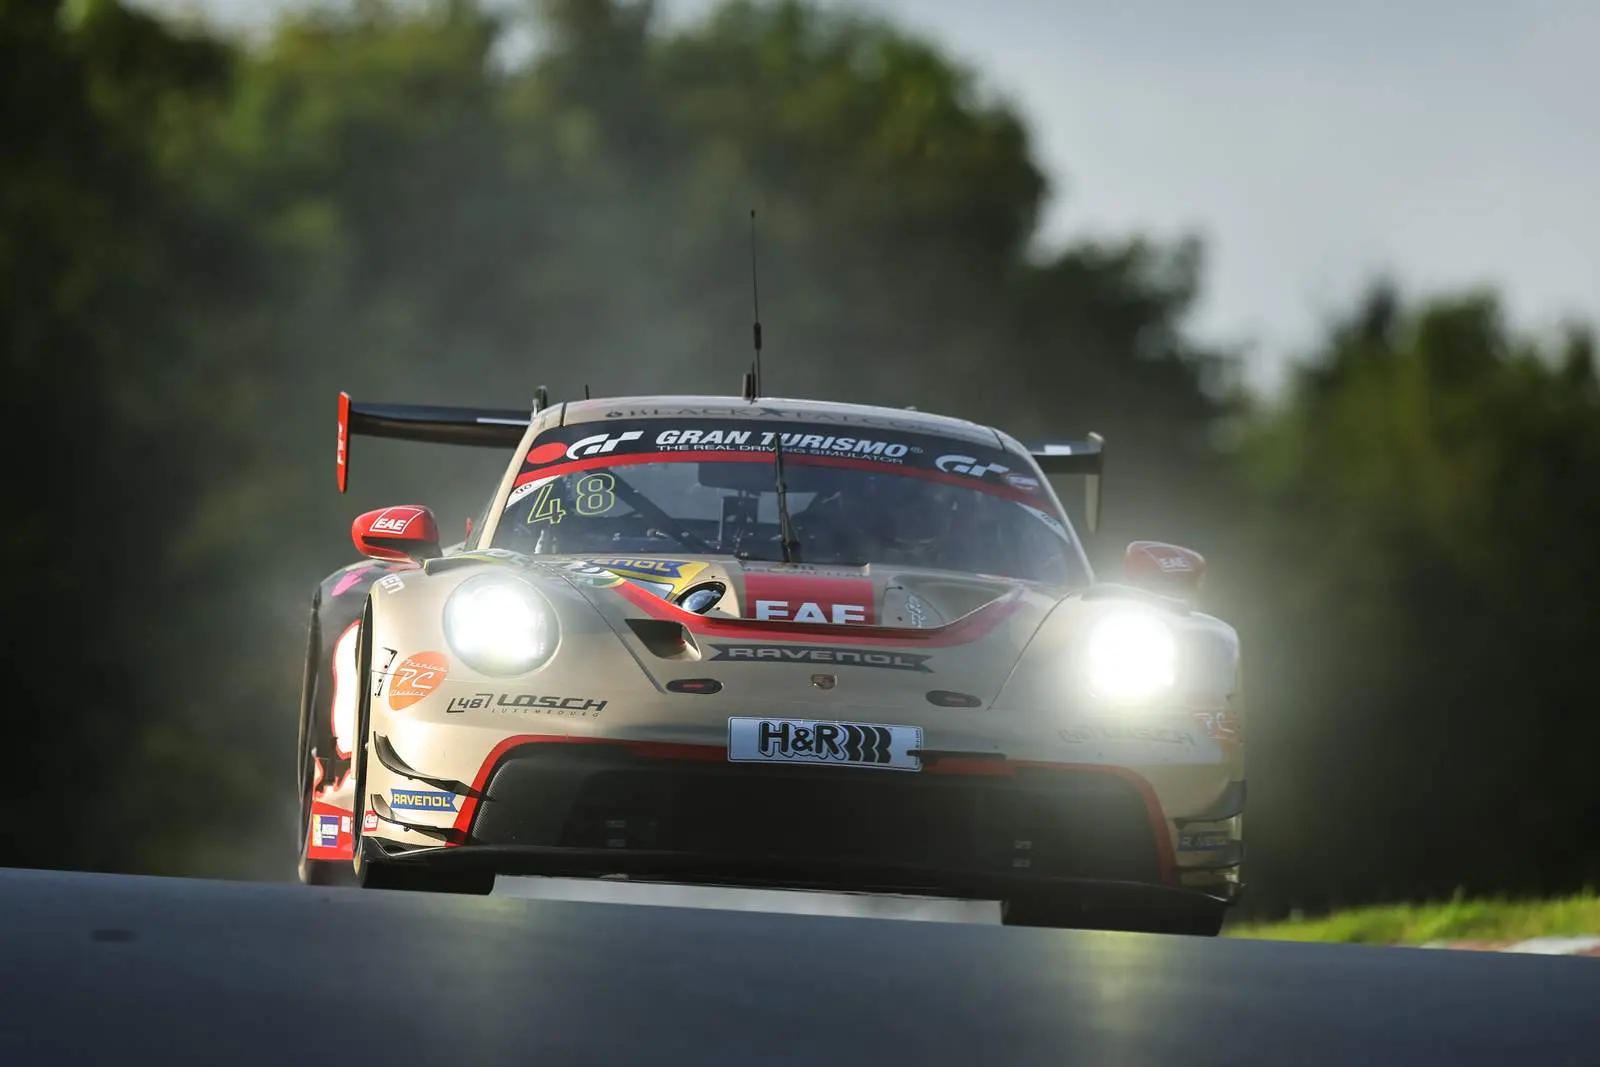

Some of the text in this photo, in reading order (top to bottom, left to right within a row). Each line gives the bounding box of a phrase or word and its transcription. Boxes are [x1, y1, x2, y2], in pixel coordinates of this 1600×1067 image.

[655, 430, 908, 457] GRAN TURISMO
[810, 449, 903, 464] SIMULATOR
[527, 473, 615, 525] 48
[375, 518, 407, 531] EAE
[728, 647, 916, 667] RAVENOL
[396, 668, 434, 689] PC
[497, 693, 609, 712] LOSCH
[758, 721, 847, 760] H&R
[393, 794, 451, 807] RAVENOL
